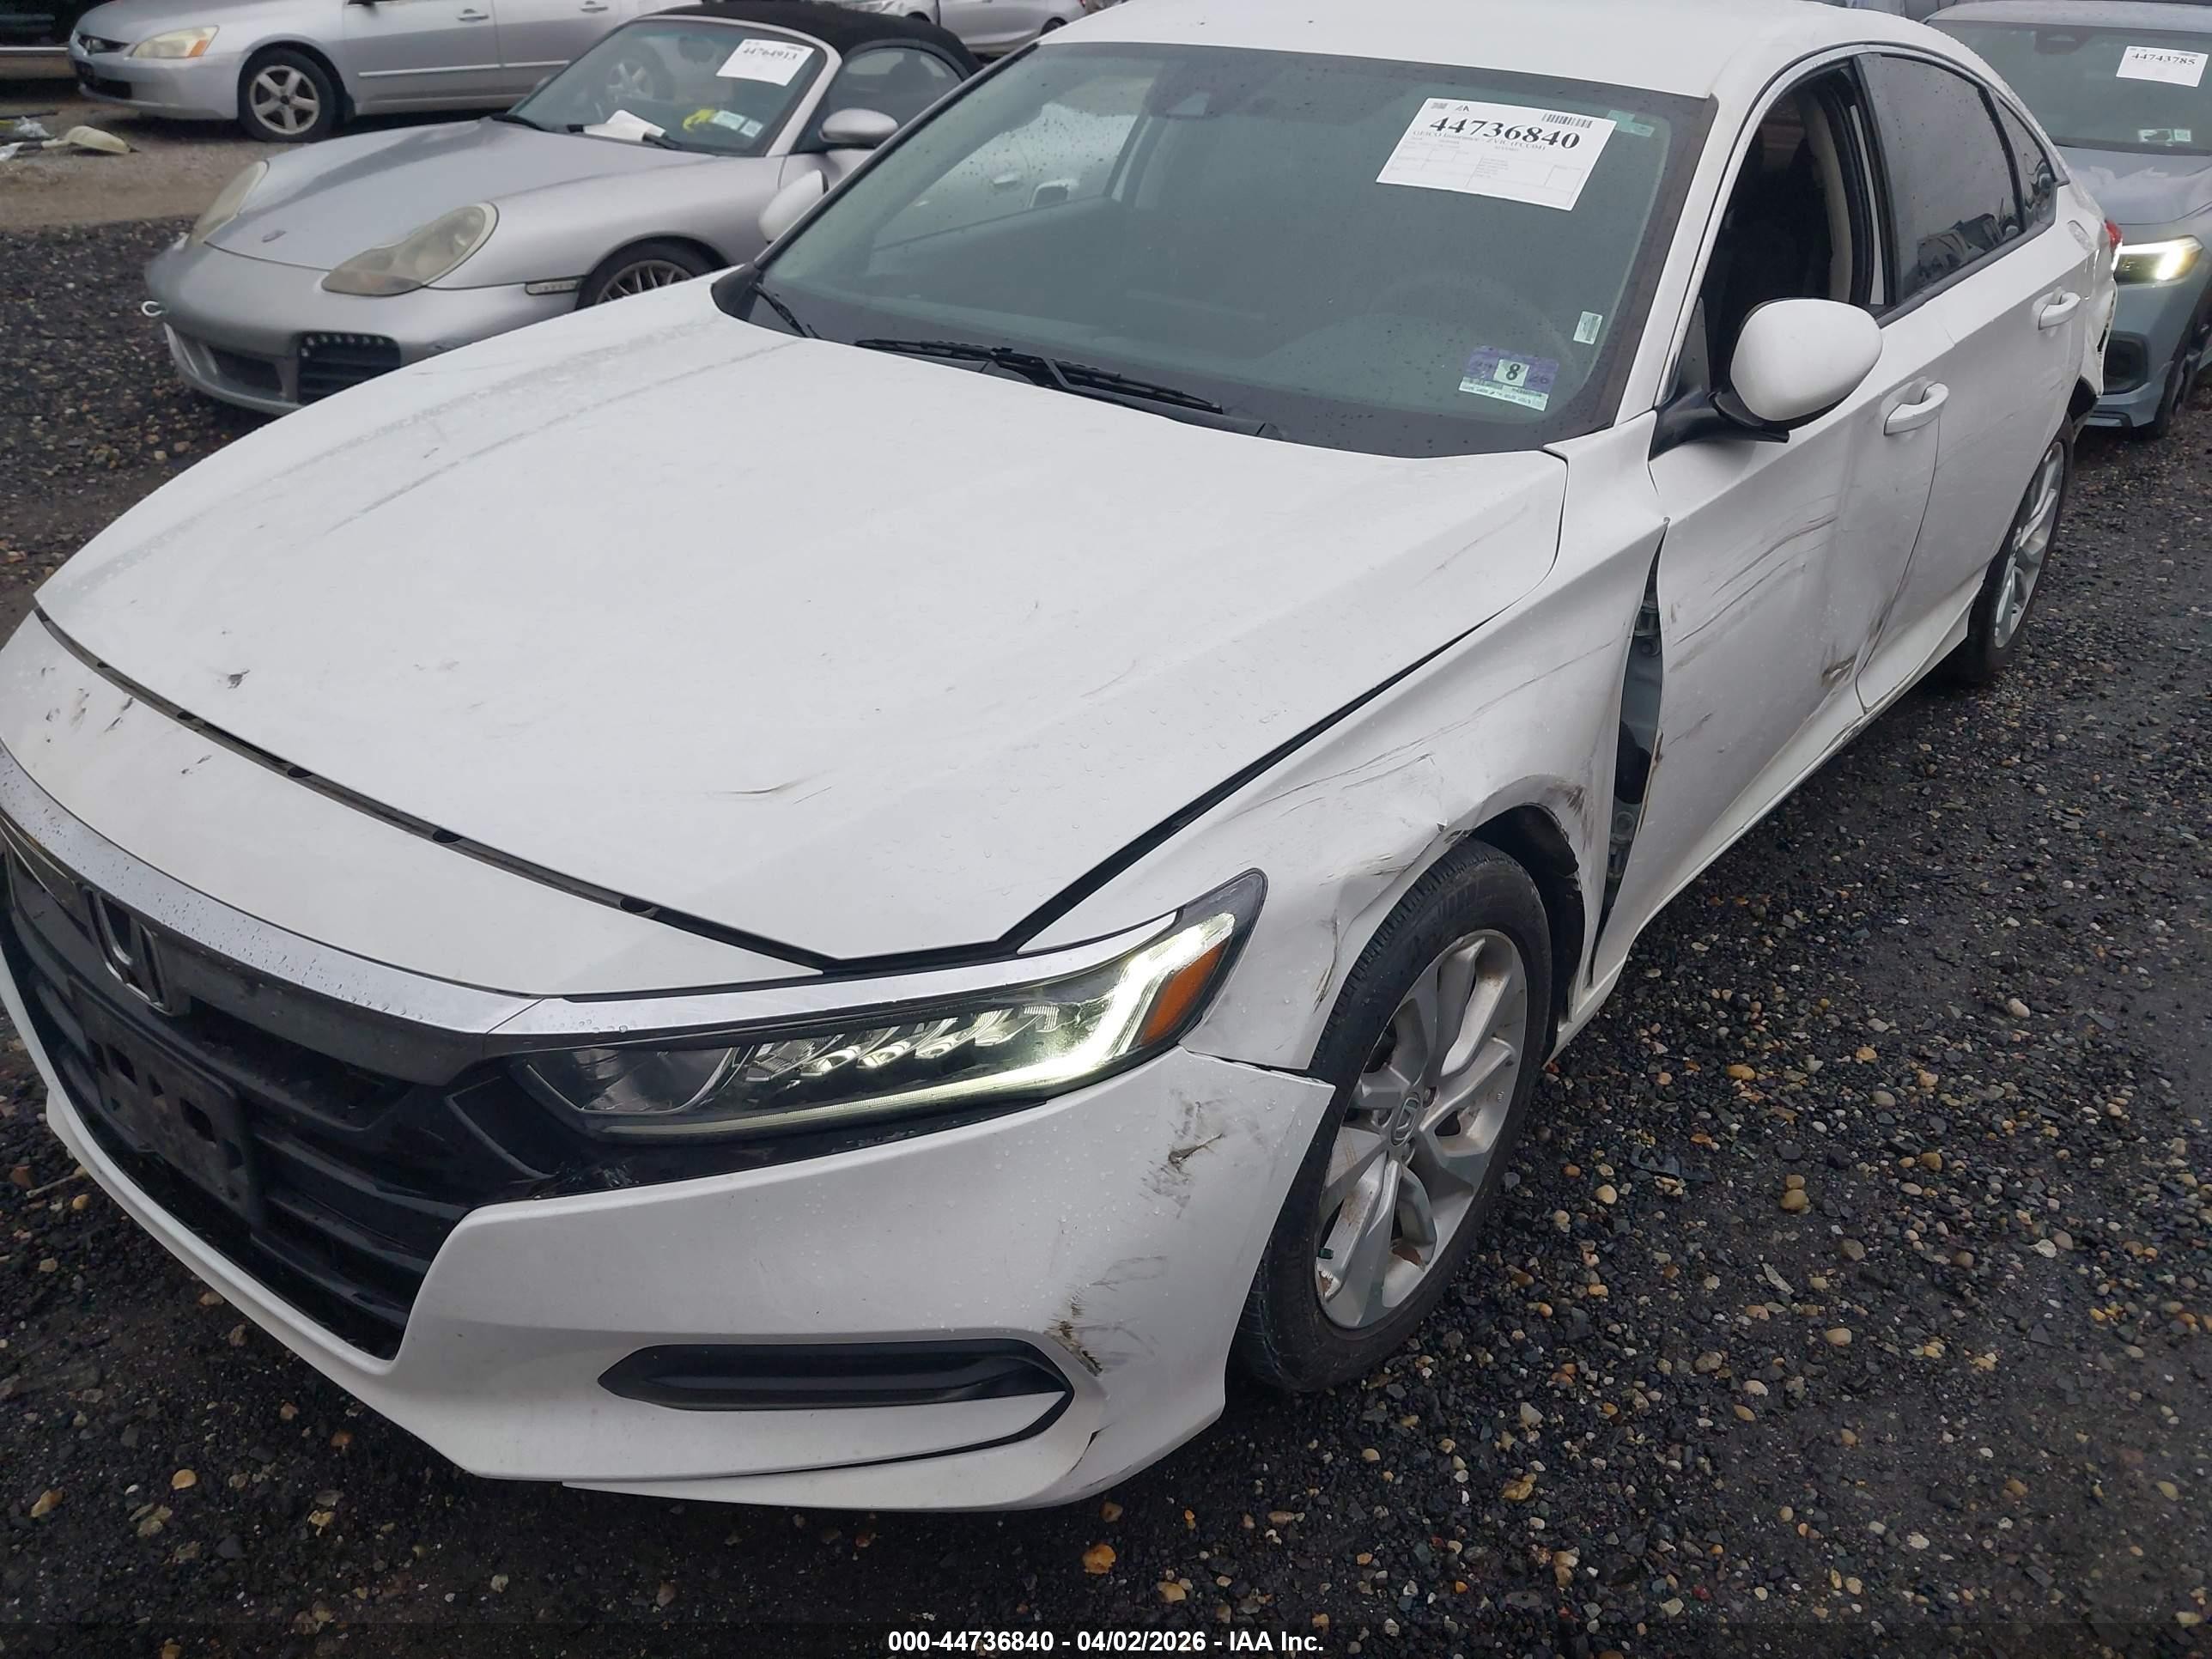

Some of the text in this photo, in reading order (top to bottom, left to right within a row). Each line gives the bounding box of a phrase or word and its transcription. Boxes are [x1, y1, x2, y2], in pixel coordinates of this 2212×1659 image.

[2131, 53, 2197, 65] 44743785
[1429, 116, 1580, 149] 44736840
[1505, 363, 1521, 380] 8
